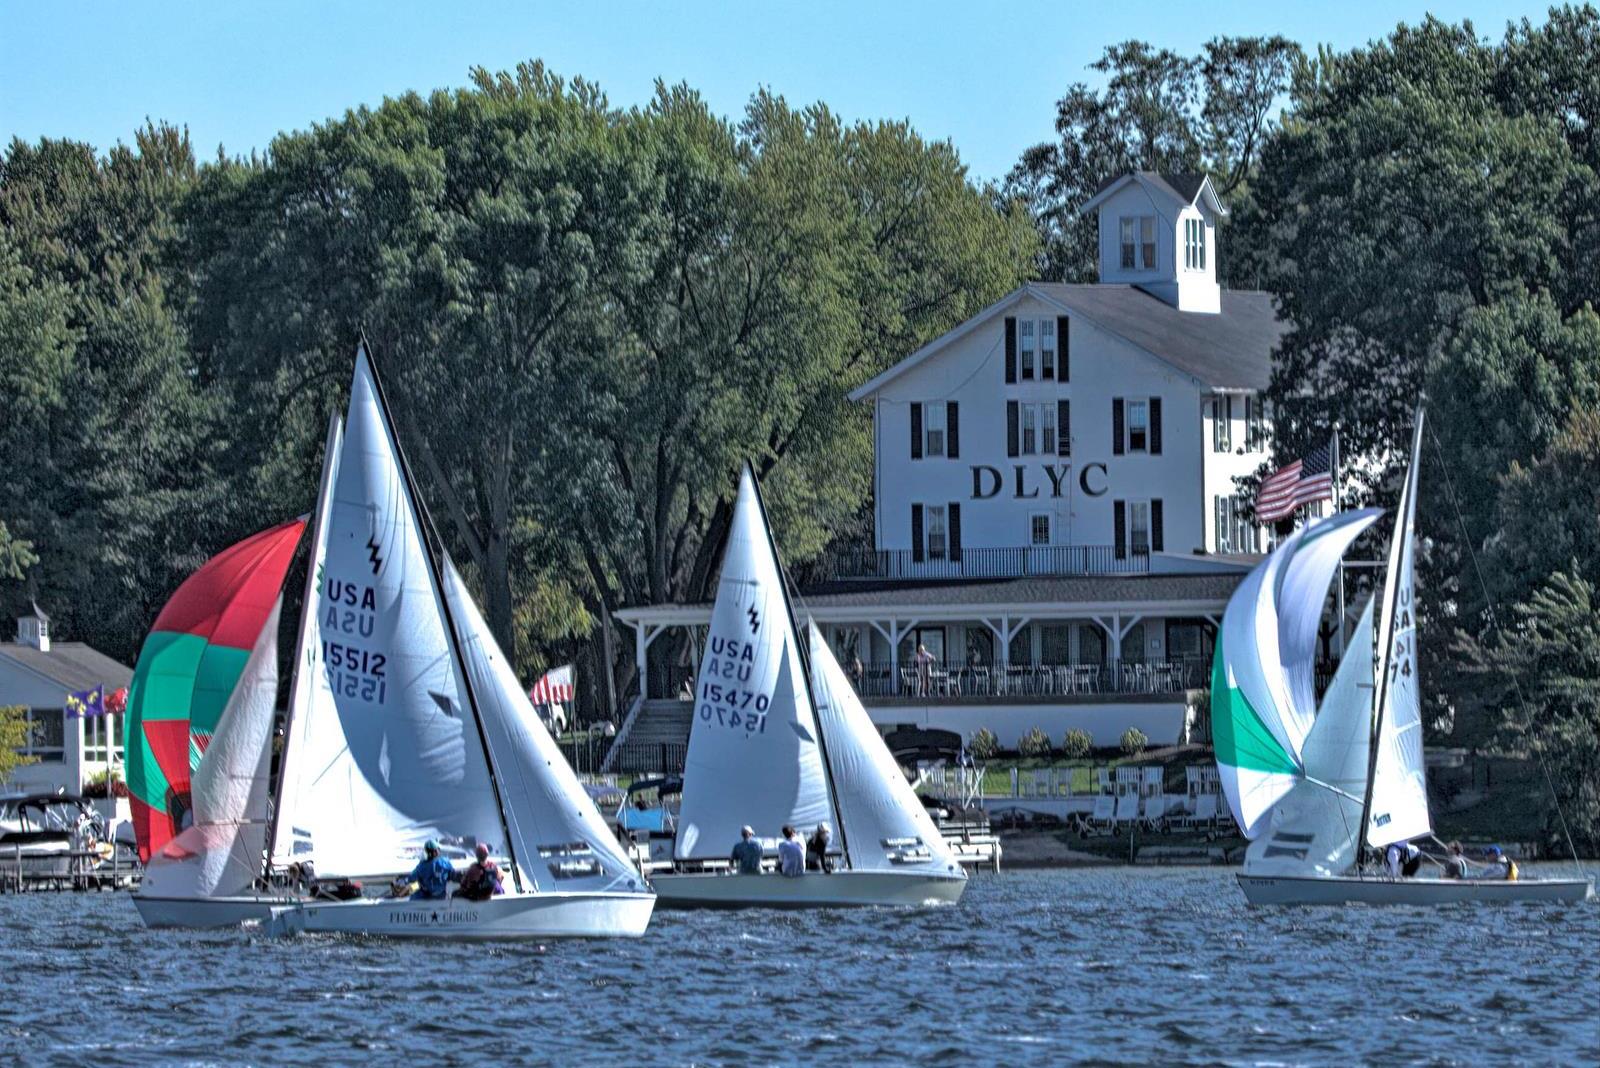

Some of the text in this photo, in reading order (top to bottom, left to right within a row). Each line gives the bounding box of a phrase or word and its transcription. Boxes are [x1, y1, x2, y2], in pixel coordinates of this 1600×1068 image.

[970, 462, 1109, 500] DLYC
[327, 578, 376, 612] USA
[323, 640, 387, 678] 15512
[711, 636, 753, 662] USA
[703, 682, 769, 713] 15470
[389, 910, 479, 924] FLYING CIRCUS
